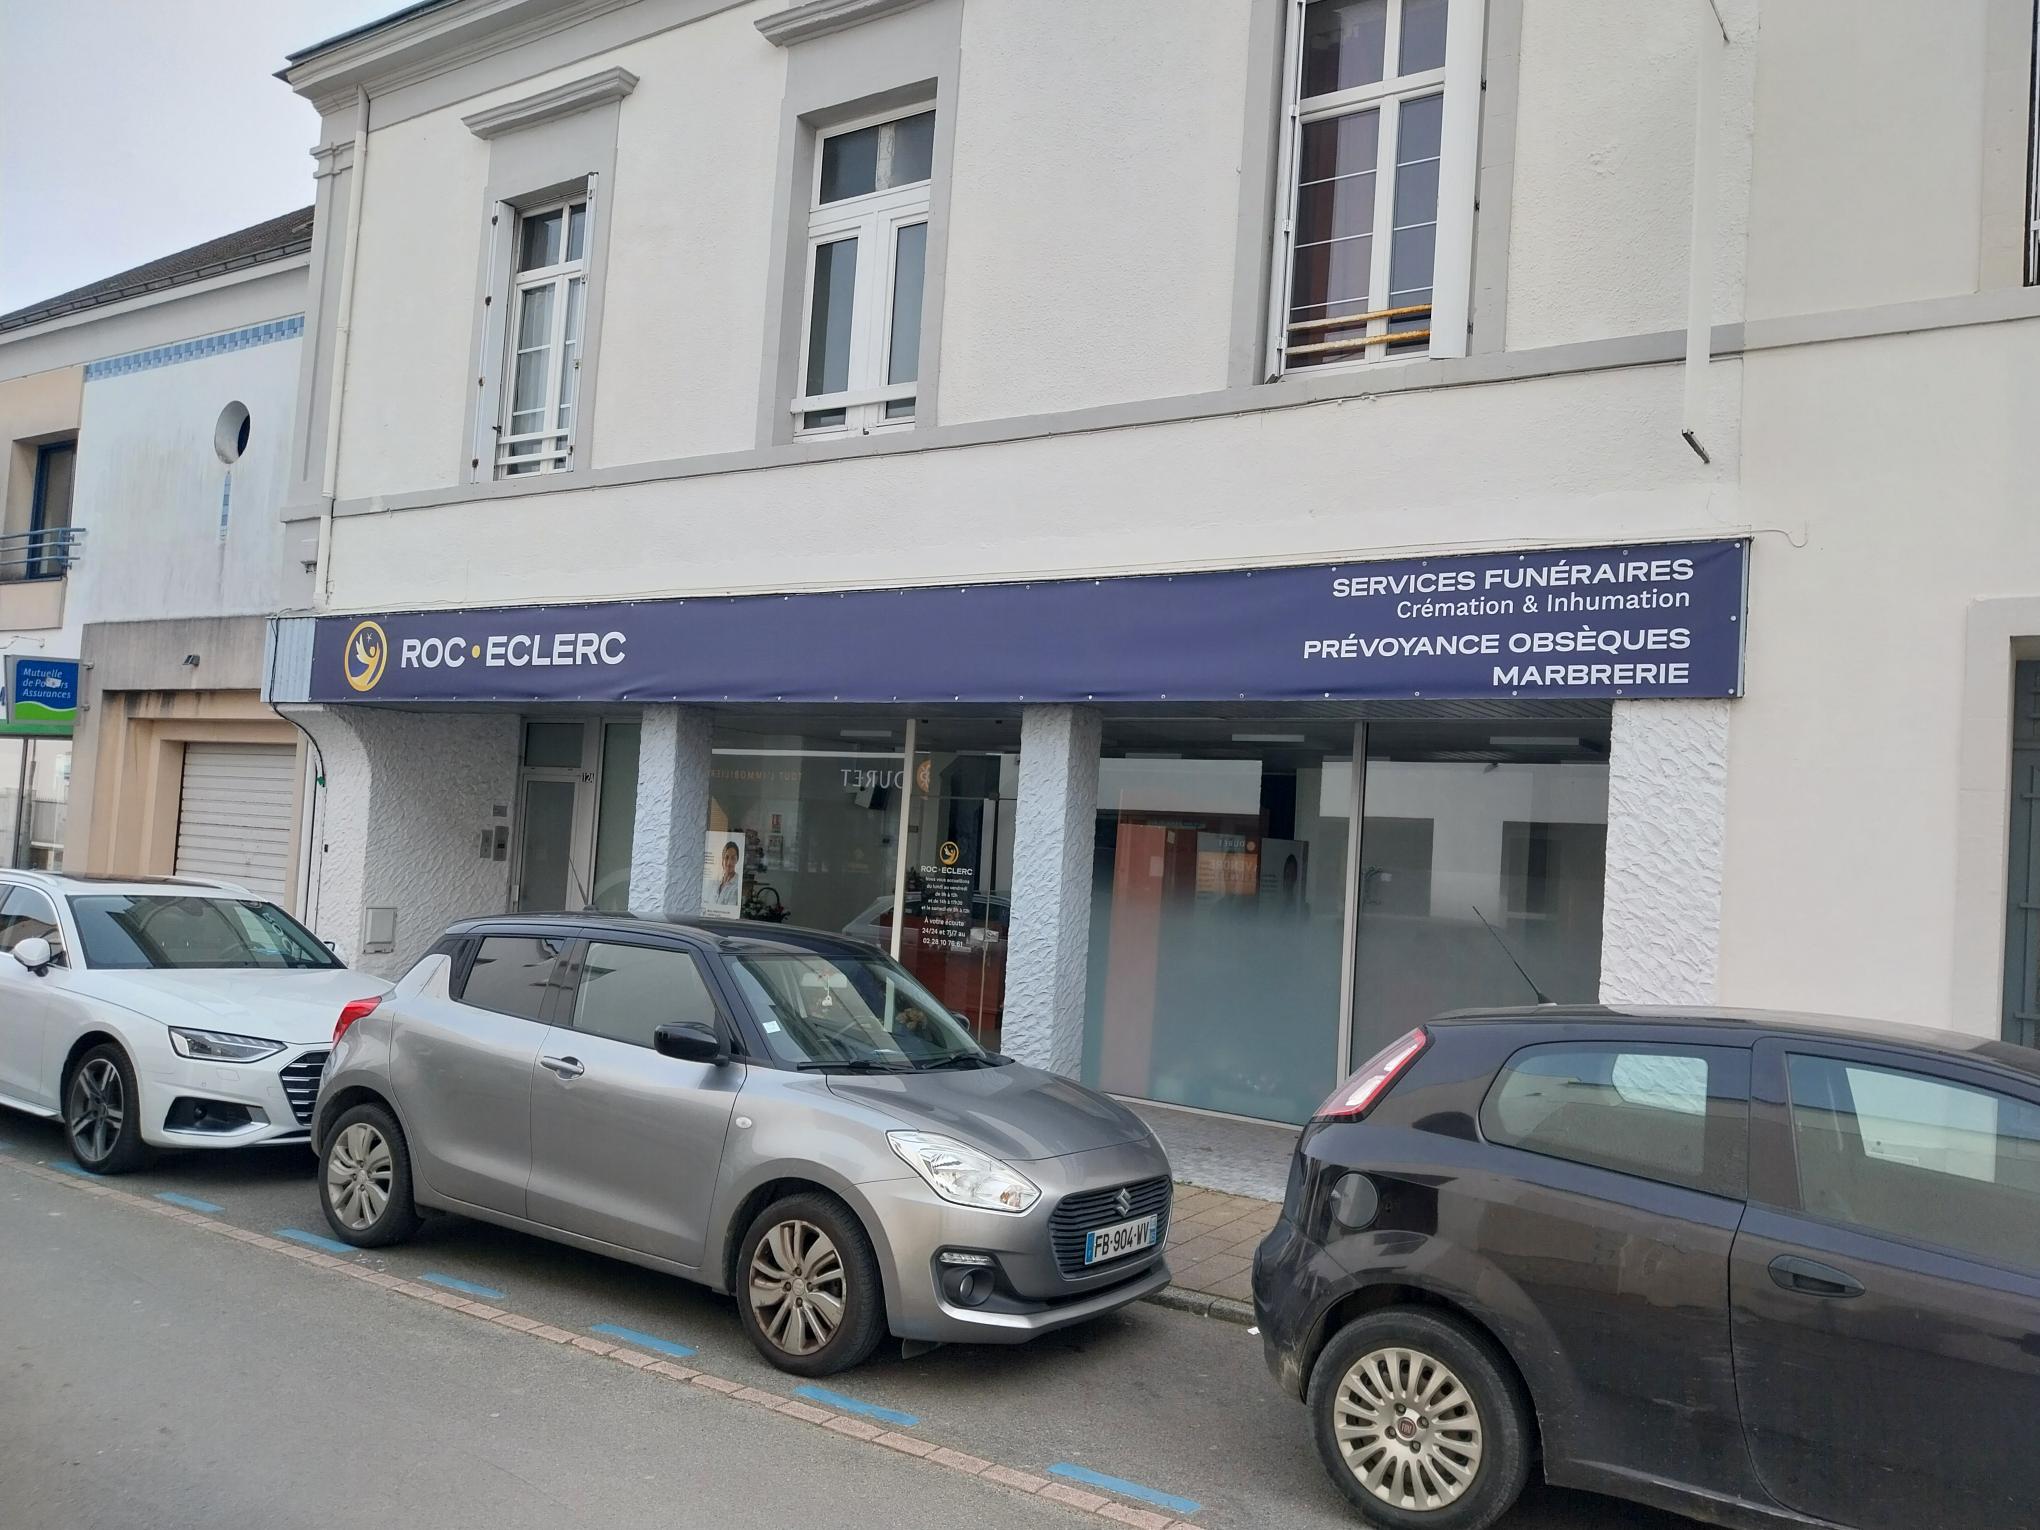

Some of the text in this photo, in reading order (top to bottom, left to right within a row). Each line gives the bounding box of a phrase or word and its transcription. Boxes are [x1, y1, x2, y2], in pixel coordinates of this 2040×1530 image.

[1333, 559, 1695, 598] SERVICES FUNÉRAIRES
[1397, 588, 1691, 619] Crémation & Inhumation
[485, 631, 627, 667] ECLERC
[1303, 625, 1691, 659] PRÉVOYANCE OBSÈQUES
[23, 668, 63, 678] Mutuelle
[1492, 663, 1690, 686] MARBRERIE
[22, 679, 33, 687] de
[22, 689, 71, 698] Assurances
[941, 867, 973, 875] ECLERC
[945, 919, 965, 927] écoute
